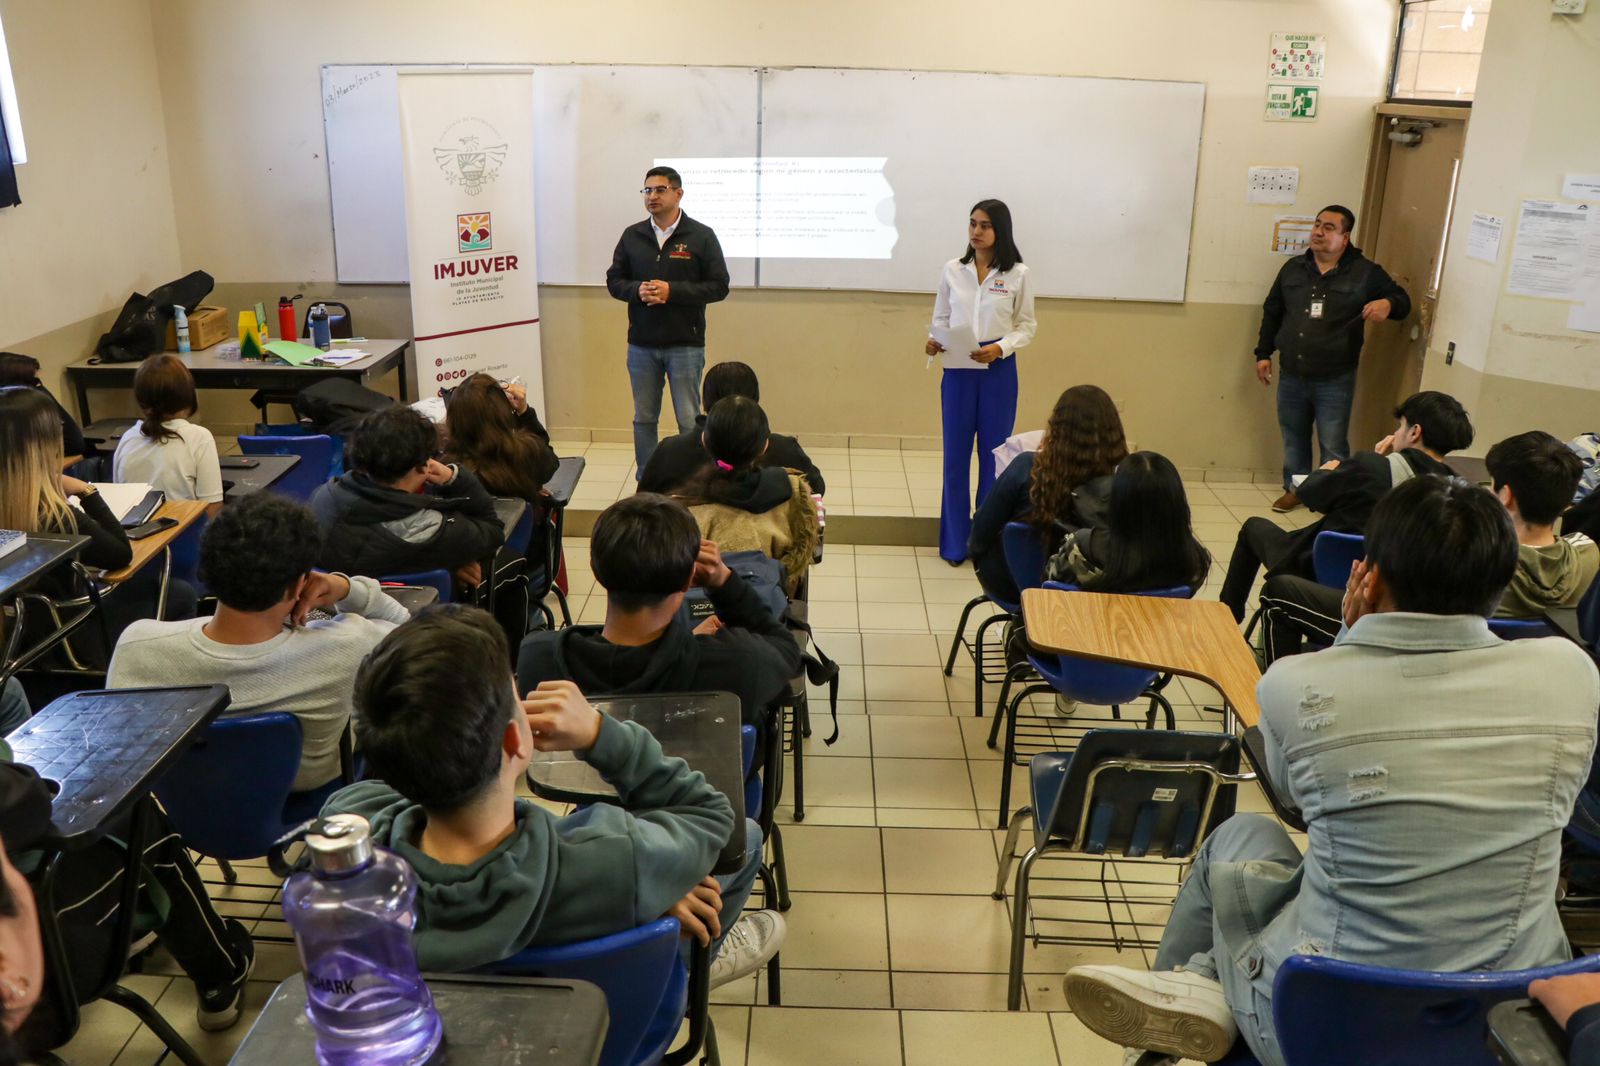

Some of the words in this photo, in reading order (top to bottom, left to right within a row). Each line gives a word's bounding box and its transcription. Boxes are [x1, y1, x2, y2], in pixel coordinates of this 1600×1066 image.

[434, 255, 518, 279] IMJUVER
[450, 279, 475, 288] Instituto
[476, 275, 504, 285] Municipal
[456, 287, 464, 295] de
[465, 286, 471, 294] la
[472, 284, 499, 293] Juventud
[463, 291, 500, 301] AYUNTAMIENTO
